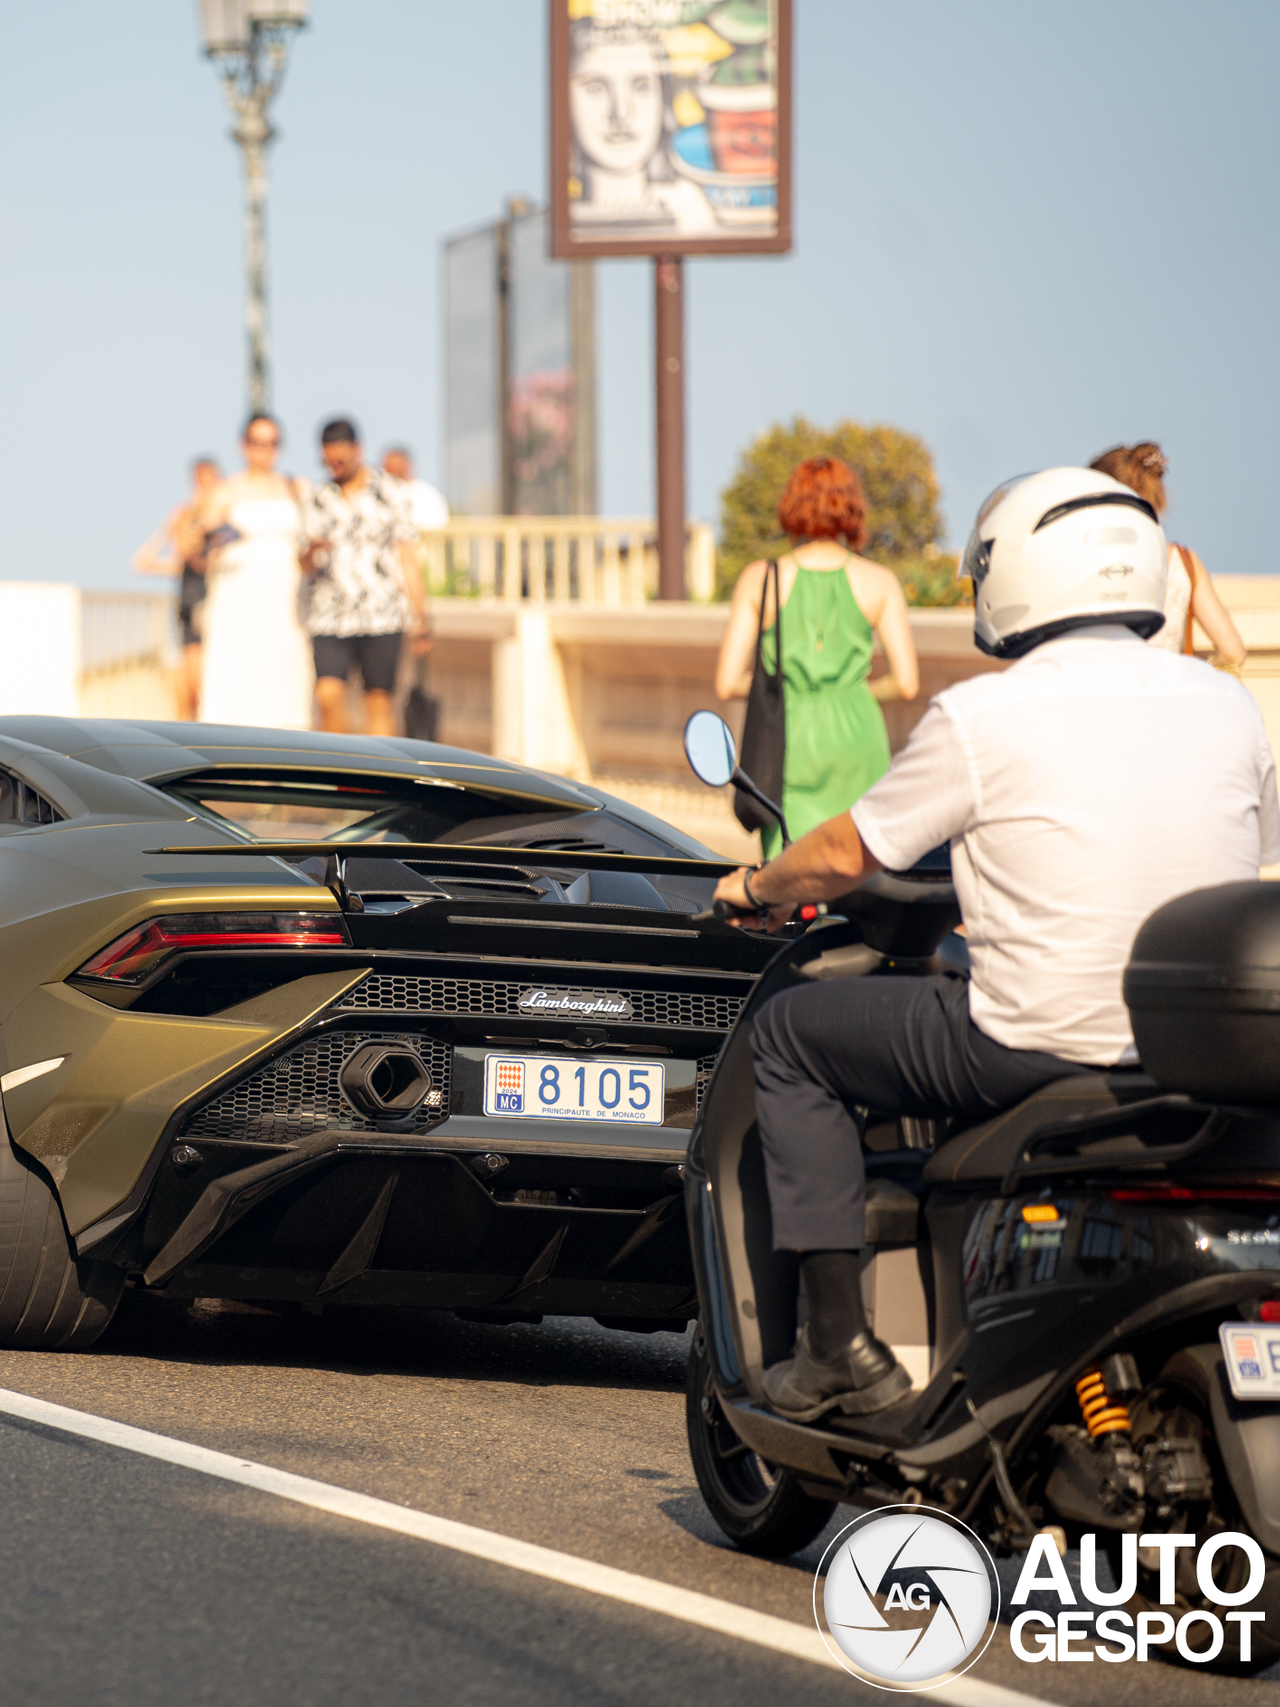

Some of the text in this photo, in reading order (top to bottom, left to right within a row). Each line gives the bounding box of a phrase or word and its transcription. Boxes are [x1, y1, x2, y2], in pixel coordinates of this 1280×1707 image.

[520, 991, 626, 1014] Lamborghini
[538, 1064, 651, 1110] 8105
[500, 1096, 518, 1110] MC
[542, 1107, 590, 1116] PRINCIPAUTE
[612, 1111, 646, 1120] MONACO
